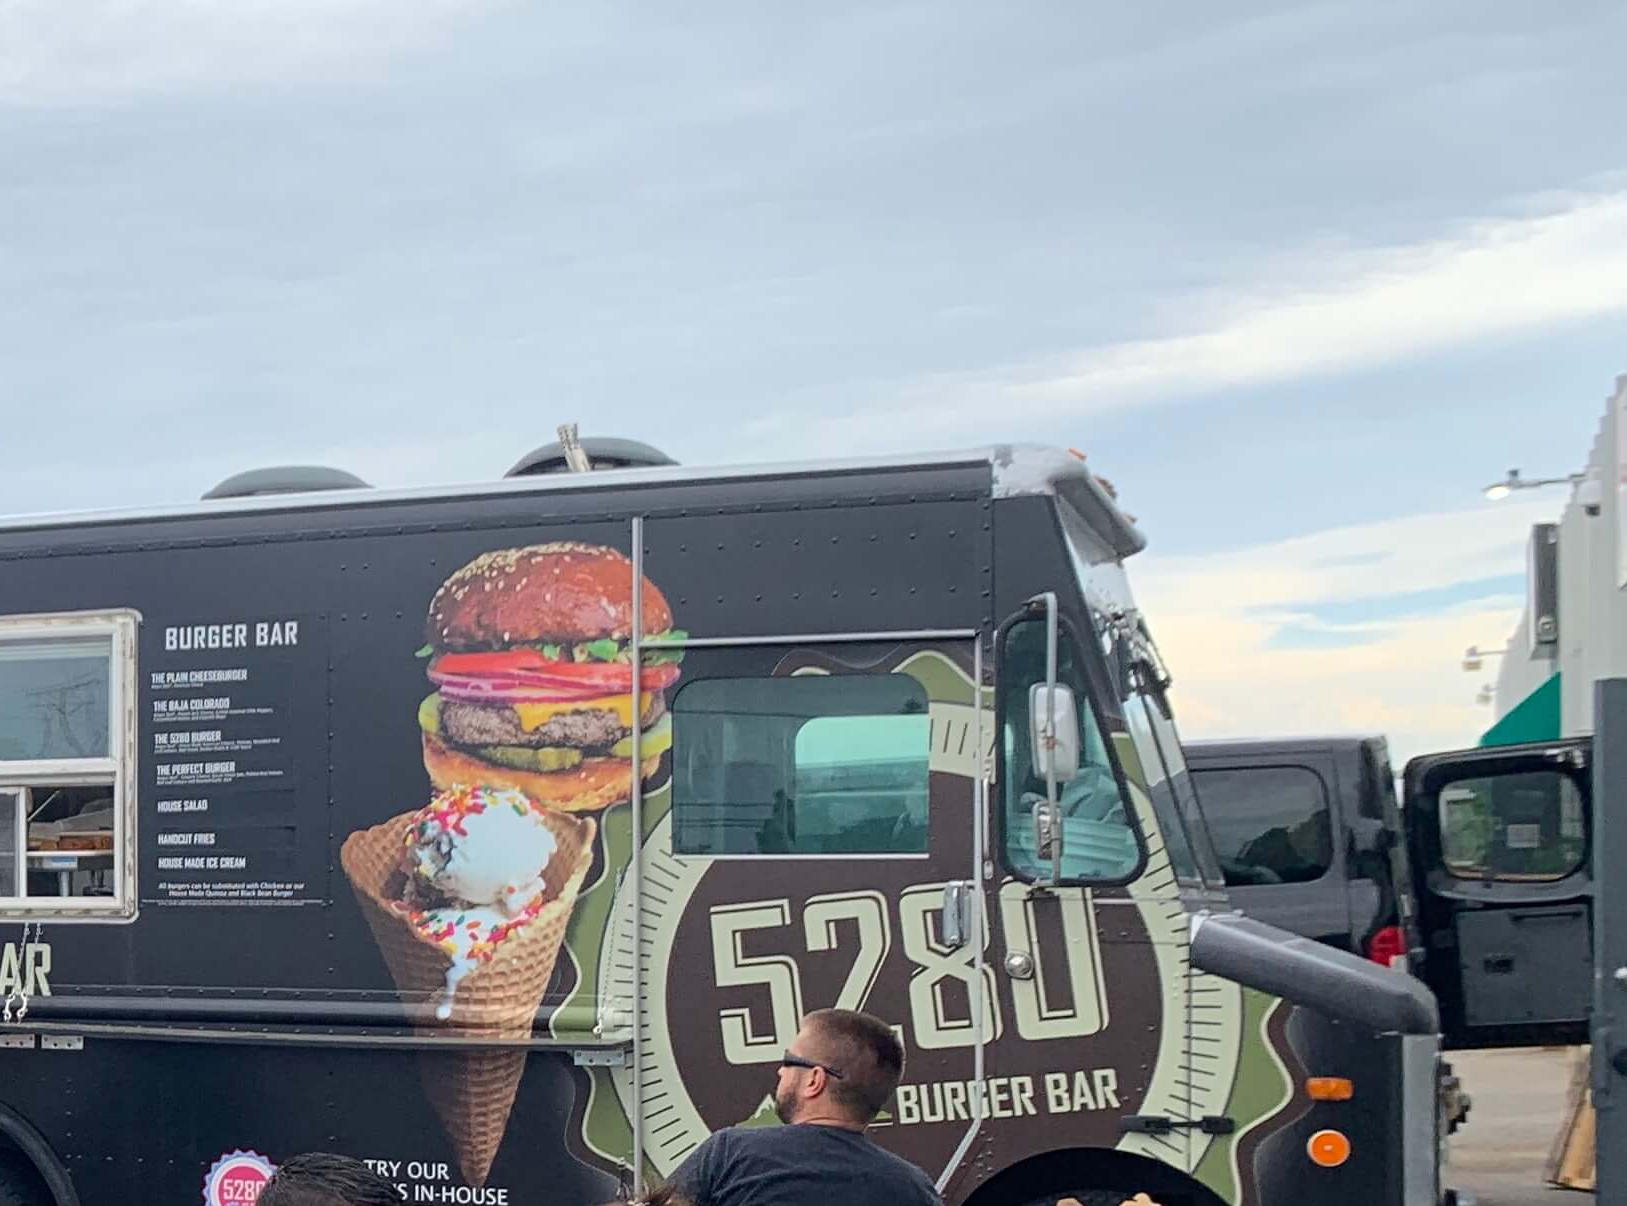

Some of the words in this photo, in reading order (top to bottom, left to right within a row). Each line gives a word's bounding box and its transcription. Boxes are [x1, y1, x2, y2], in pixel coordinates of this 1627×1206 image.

[165, 623, 247, 650] BURGER
[256, 621, 298, 646] BAR
[151, 672, 166, 683] THE
[166, 671, 188, 683] PLAIN
[189, 669, 248, 682] CHEESEBURGER
[153, 700, 167, 712] THE
[168, 700, 189, 711] BAJA
[190, 697, 230, 710] COLORADO
[154, 733, 168, 744] THE
[169, 732, 190, 743] 5280
[191, 731, 221, 742] BURGER
[157, 765, 171, 775] THE
[172, 763, 204, 775] PERFECT
[205, 762, 235, 773] BURGER
[157, 800, 182, 812] HOUSE
[183, 799, 208, 811] SALAD
[158, 833, 192, 845] HANDCUT
[194, 833, 215, 844] FRIES
[158, 857, 183, 869] HOUSE
[184, 857, 205, 869] MADE
[206, 857, 218, 869] ICE
[219, 857, 246, 869] CREAM
[710, 880, 1111, 1066] 5280
[898, 1075, 1038, 1125] BURGER
[1044, 1068, 1121, 1113] BAR
[363, 1159, 401, 1178] TRY
[407, 1161, 450, 1180] OUR
[414, 1183, 509, 1206] IN-HOUSE
